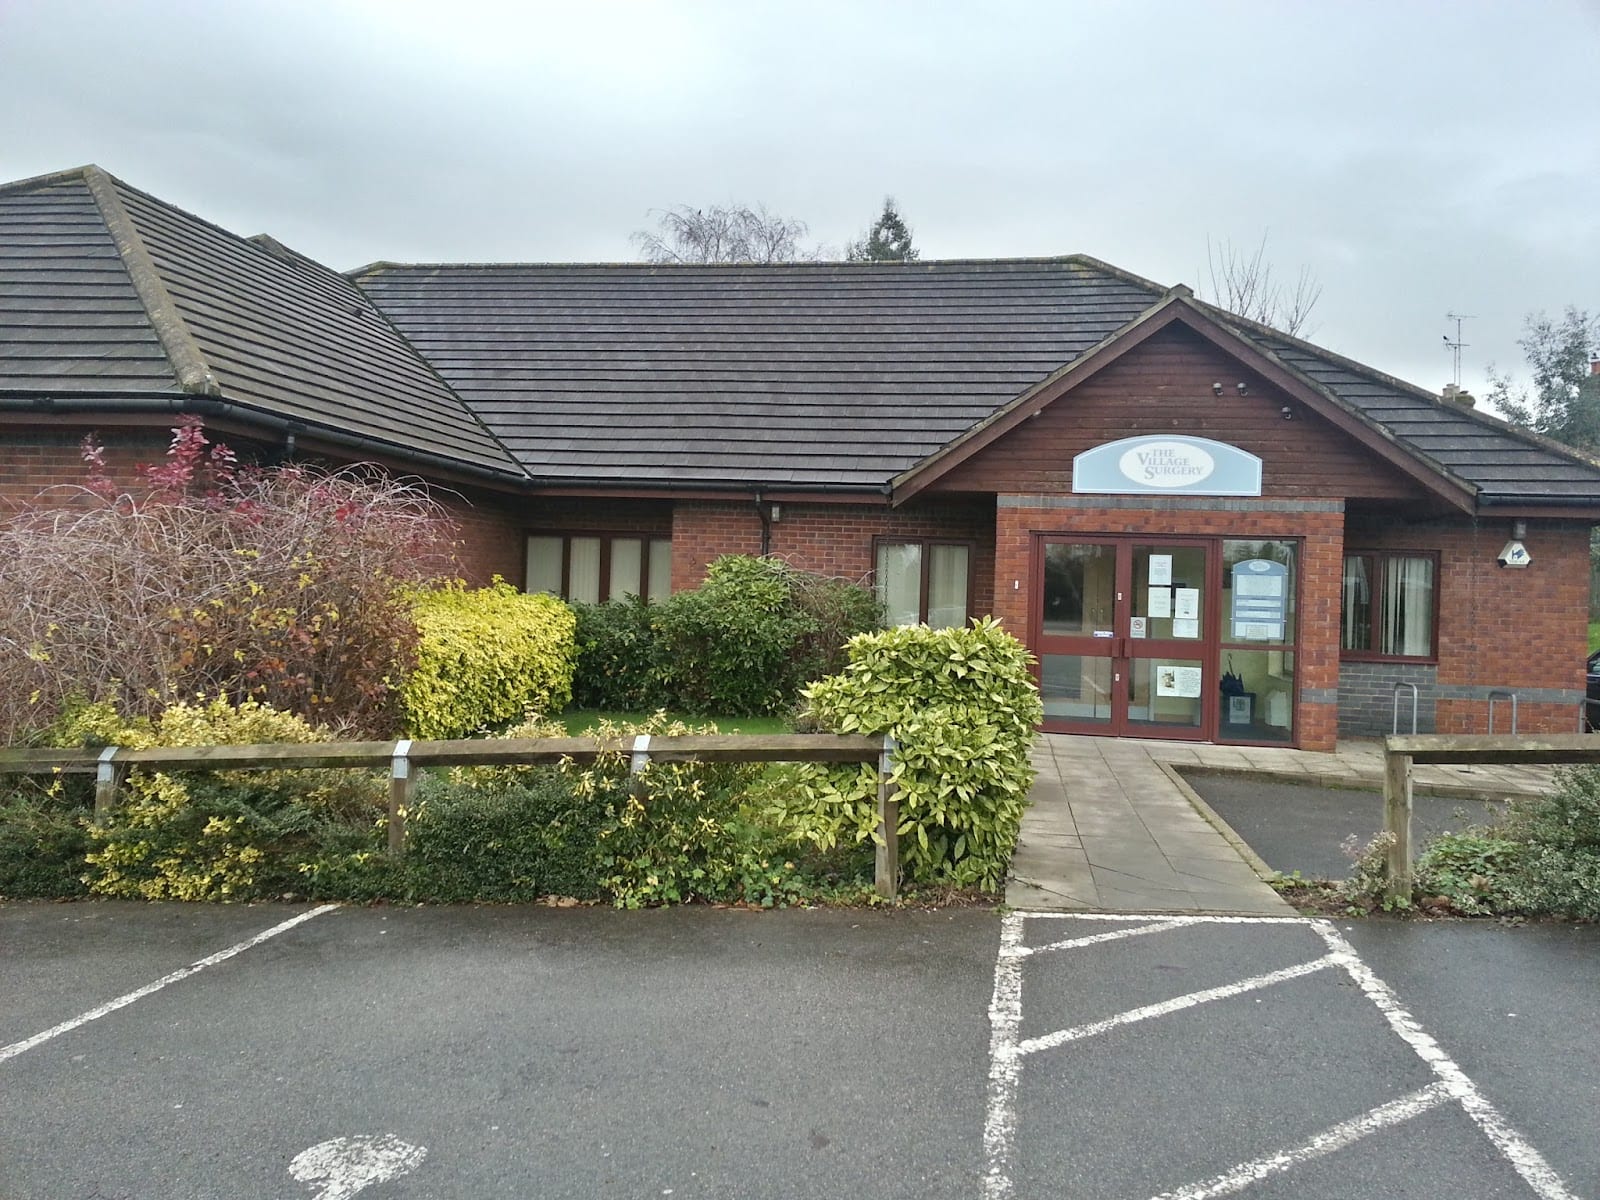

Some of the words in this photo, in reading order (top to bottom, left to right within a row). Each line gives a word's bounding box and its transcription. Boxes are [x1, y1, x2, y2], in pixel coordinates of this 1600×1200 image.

[1138, 452, 1190, 466] VILLAGE
[1153, 449, 1176, 457] THE
[1144, 466, 1202, 480] SURGERY
